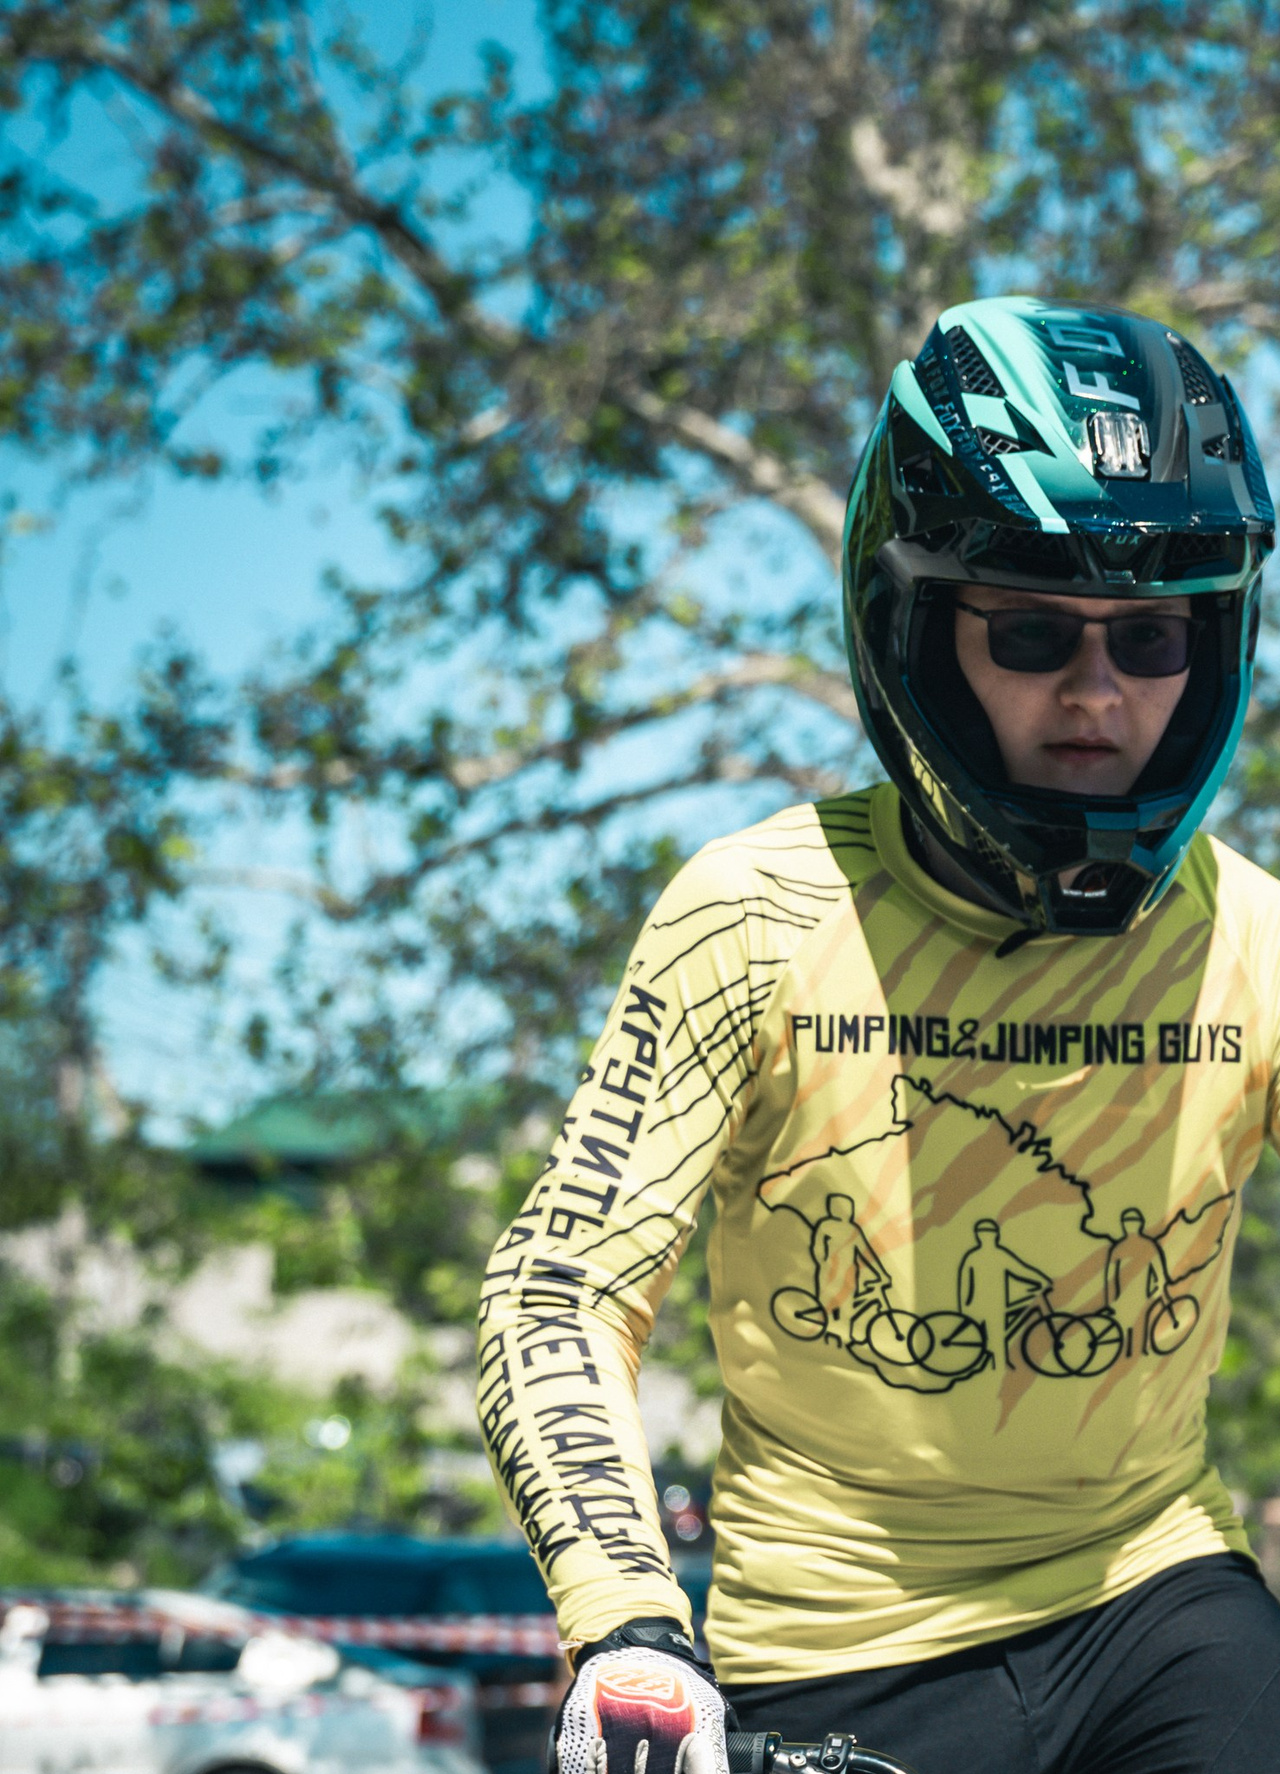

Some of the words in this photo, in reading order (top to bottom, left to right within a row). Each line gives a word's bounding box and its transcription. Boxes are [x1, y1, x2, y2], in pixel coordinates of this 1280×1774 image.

[1045, 316, 1141, 411] FO
[791, 1014, 1145, 1065] PUMPING&JUMPING
[1158, 1022, 1242, 1063] GUYS
[546, 984, 667, 1240] КРУТИТЬ
